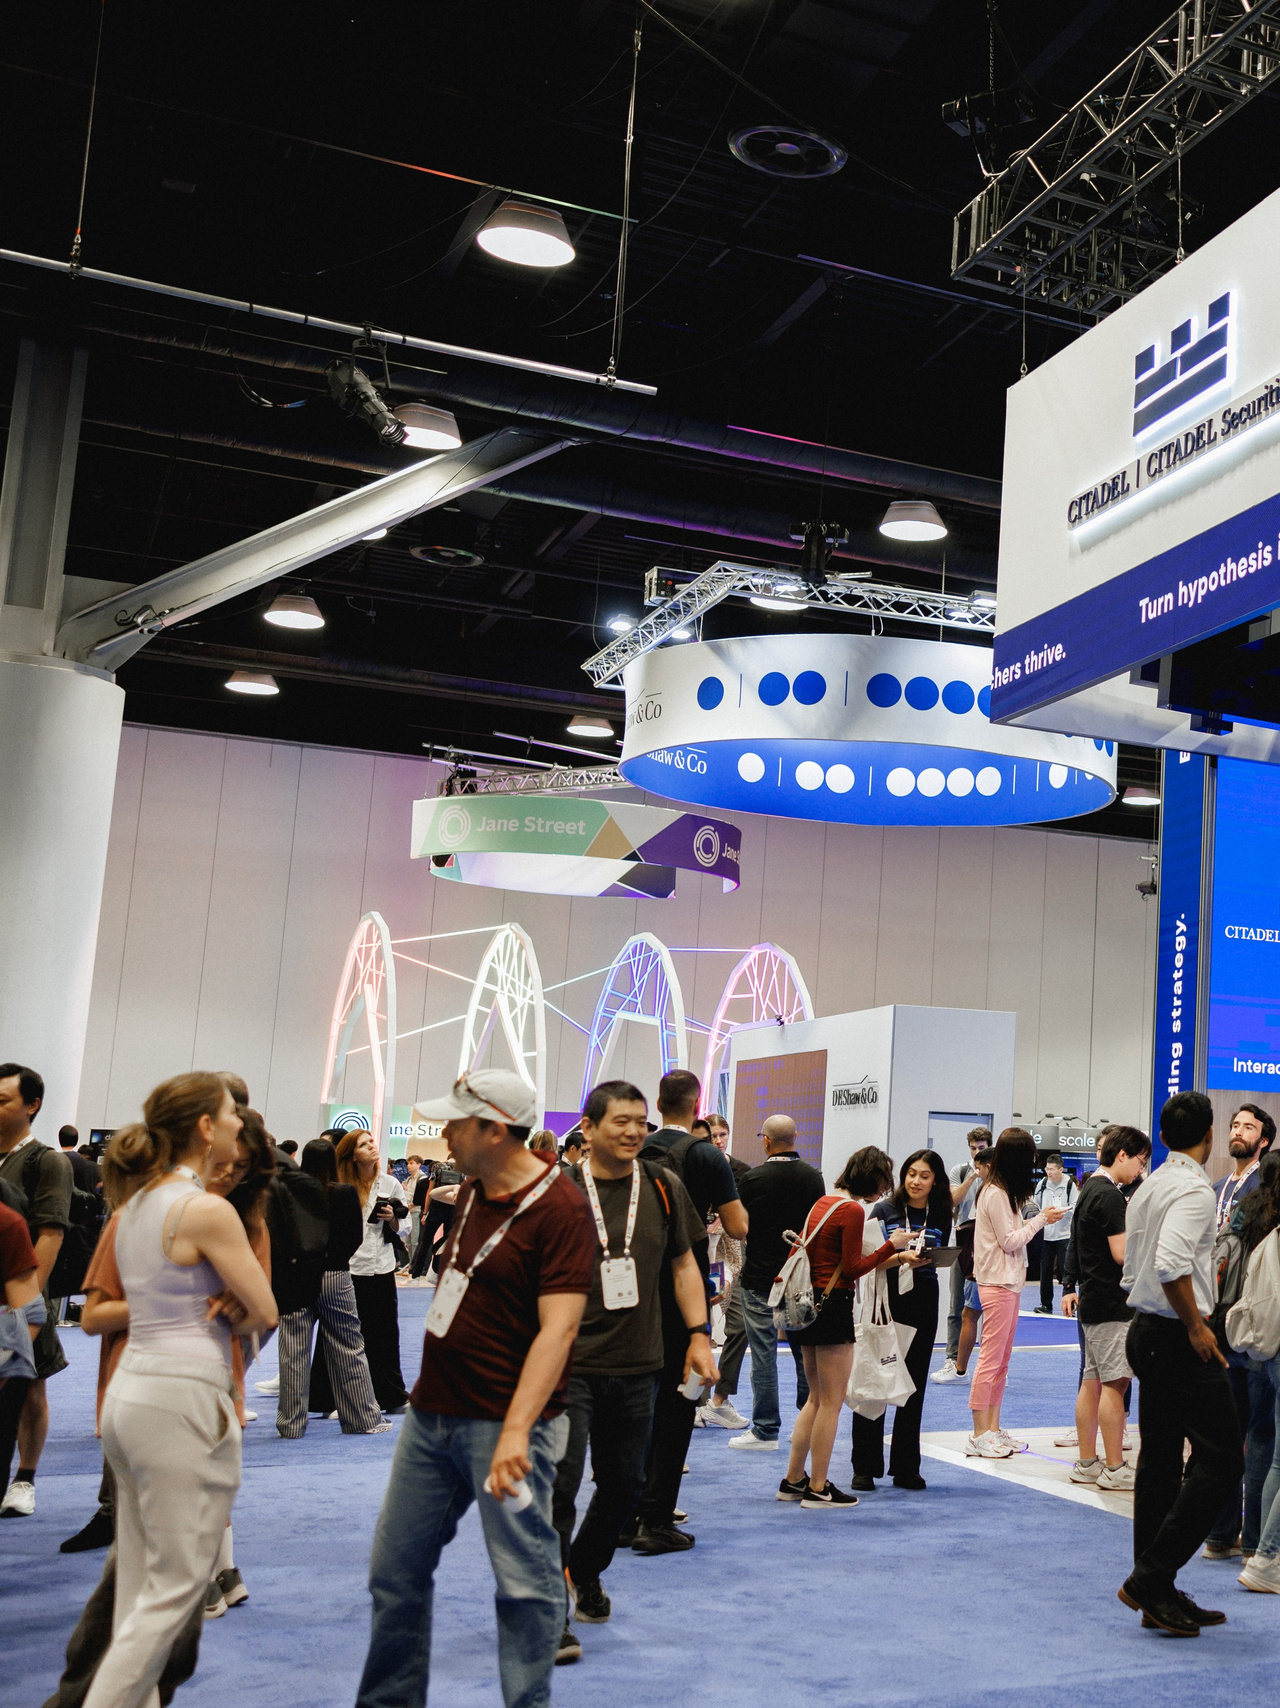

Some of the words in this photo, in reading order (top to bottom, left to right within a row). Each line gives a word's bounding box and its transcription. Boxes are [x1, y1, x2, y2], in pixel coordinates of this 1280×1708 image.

[1067, 470, 1130, 524] CITADEL
[1146, 418, 1217, 478] CITADEL
[1139, 594, 1174, 624] Turn
[1177, 542, 1272, 606] hypothesis
[1024, 643, 1067, 675] thrive.
[476, 815, 519, 834] Jane
[524, 815, 586, 836] Street
[1171, 913, 1187, 1033] strategy.
[1058, 1132, 1096, 1148] scale
